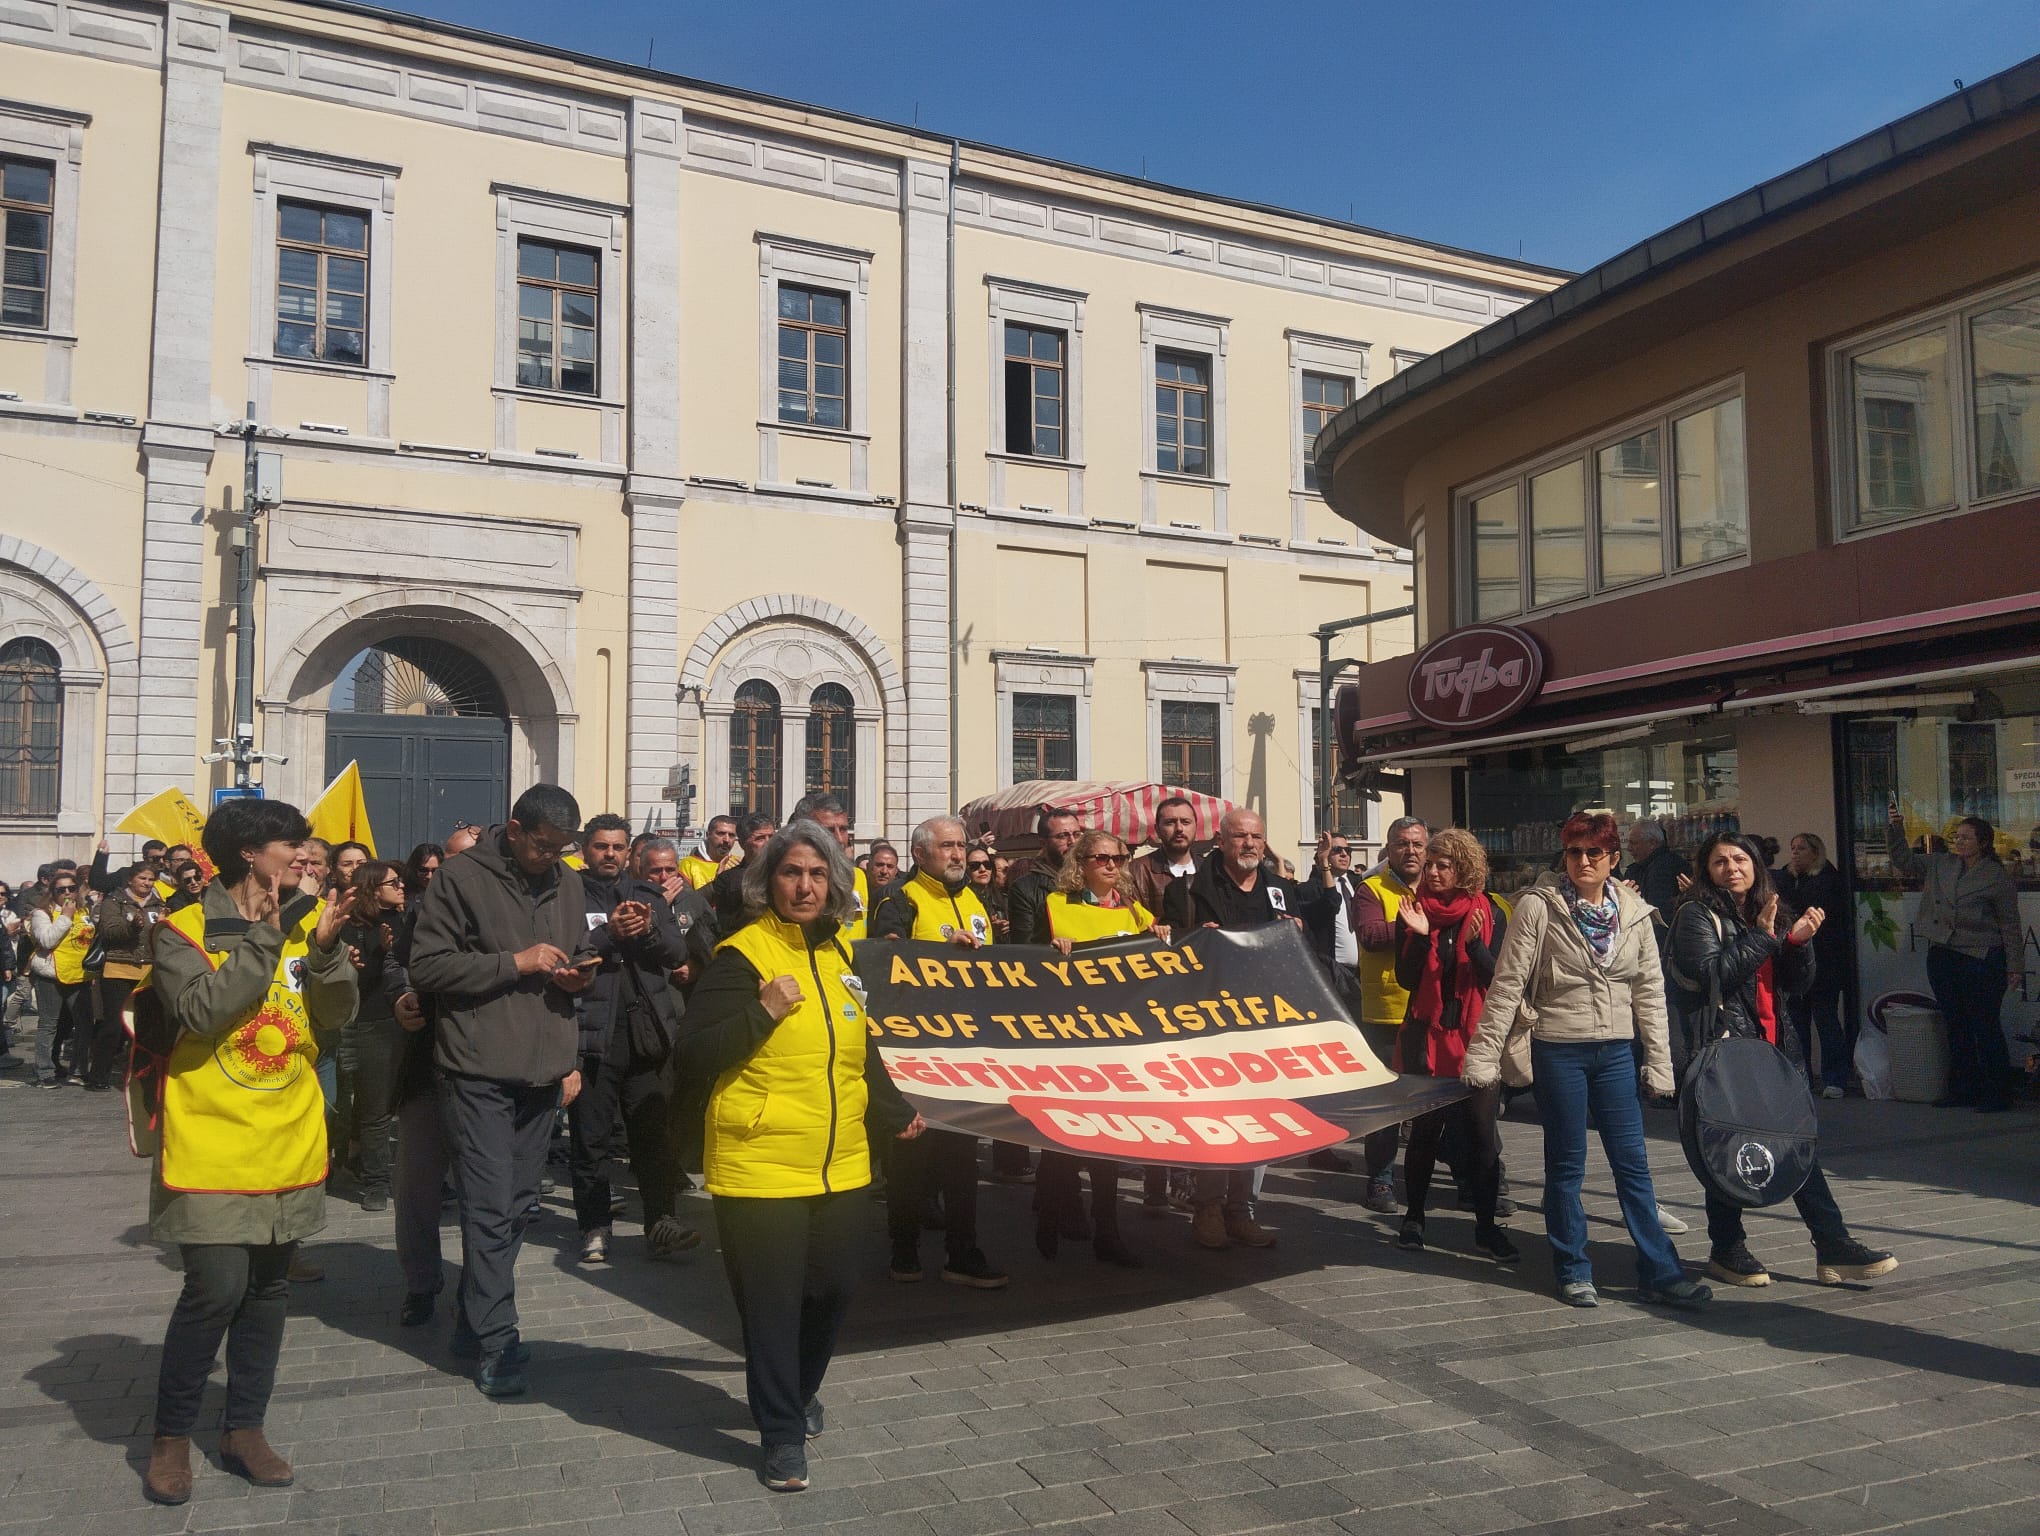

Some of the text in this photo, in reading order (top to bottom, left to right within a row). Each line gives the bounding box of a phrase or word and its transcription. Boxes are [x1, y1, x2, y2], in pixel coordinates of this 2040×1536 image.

[890, 945, 1204, 988] ARTIK YETER!
[865, 990, 1318, 1040] SUF TEKİN İSTİFA.
[1143, 1041, 1365, 1098] ŞİDDETE
[1046, 1109, 1191, 1145] DUR
[1183, 1115, 1279, 1145] DE
